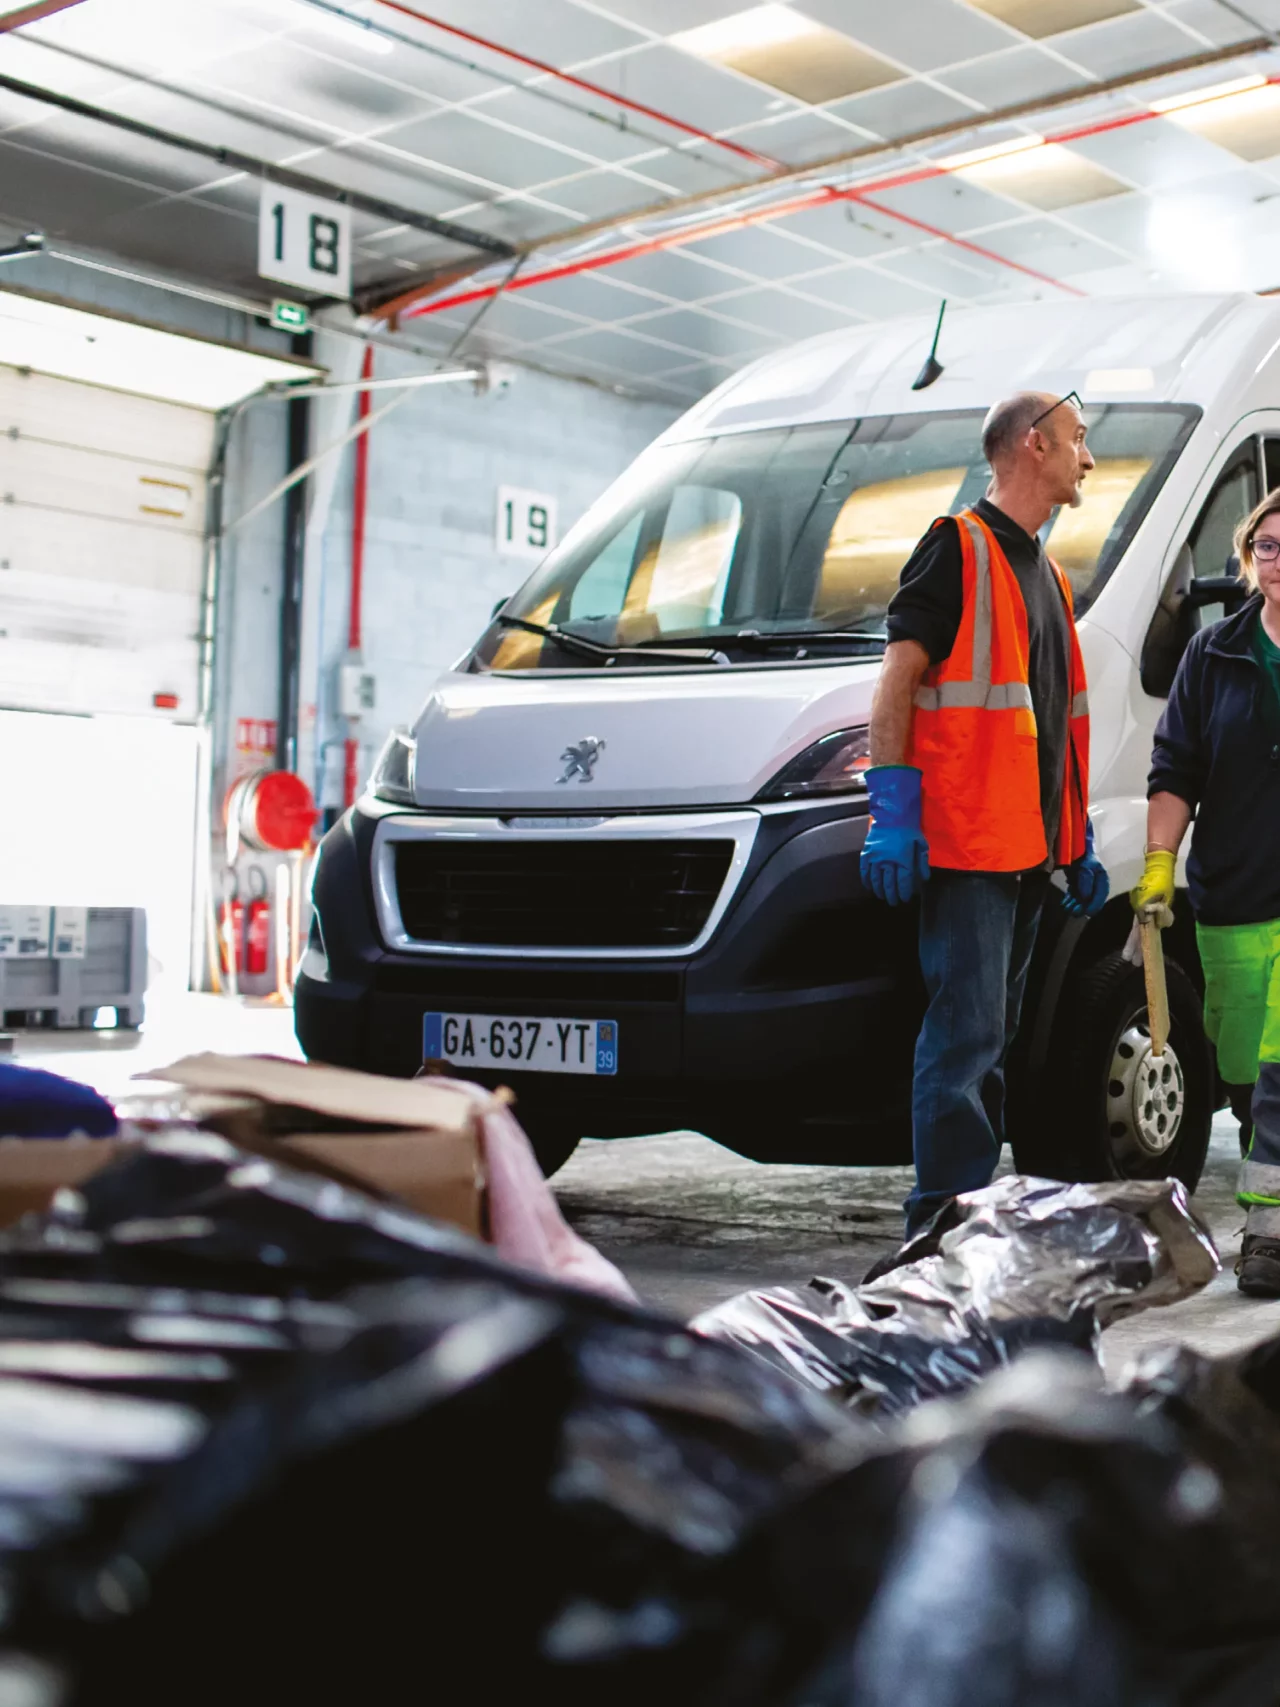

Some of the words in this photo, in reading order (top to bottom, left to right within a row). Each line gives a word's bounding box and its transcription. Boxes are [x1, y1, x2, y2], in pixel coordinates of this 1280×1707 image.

[272, 202, 340, 275] 18
[505, 500, 549, 547] 19
[443, 1017, 591, 1063] GA-637-YT
[597, 1050, 614, 1068] 39
